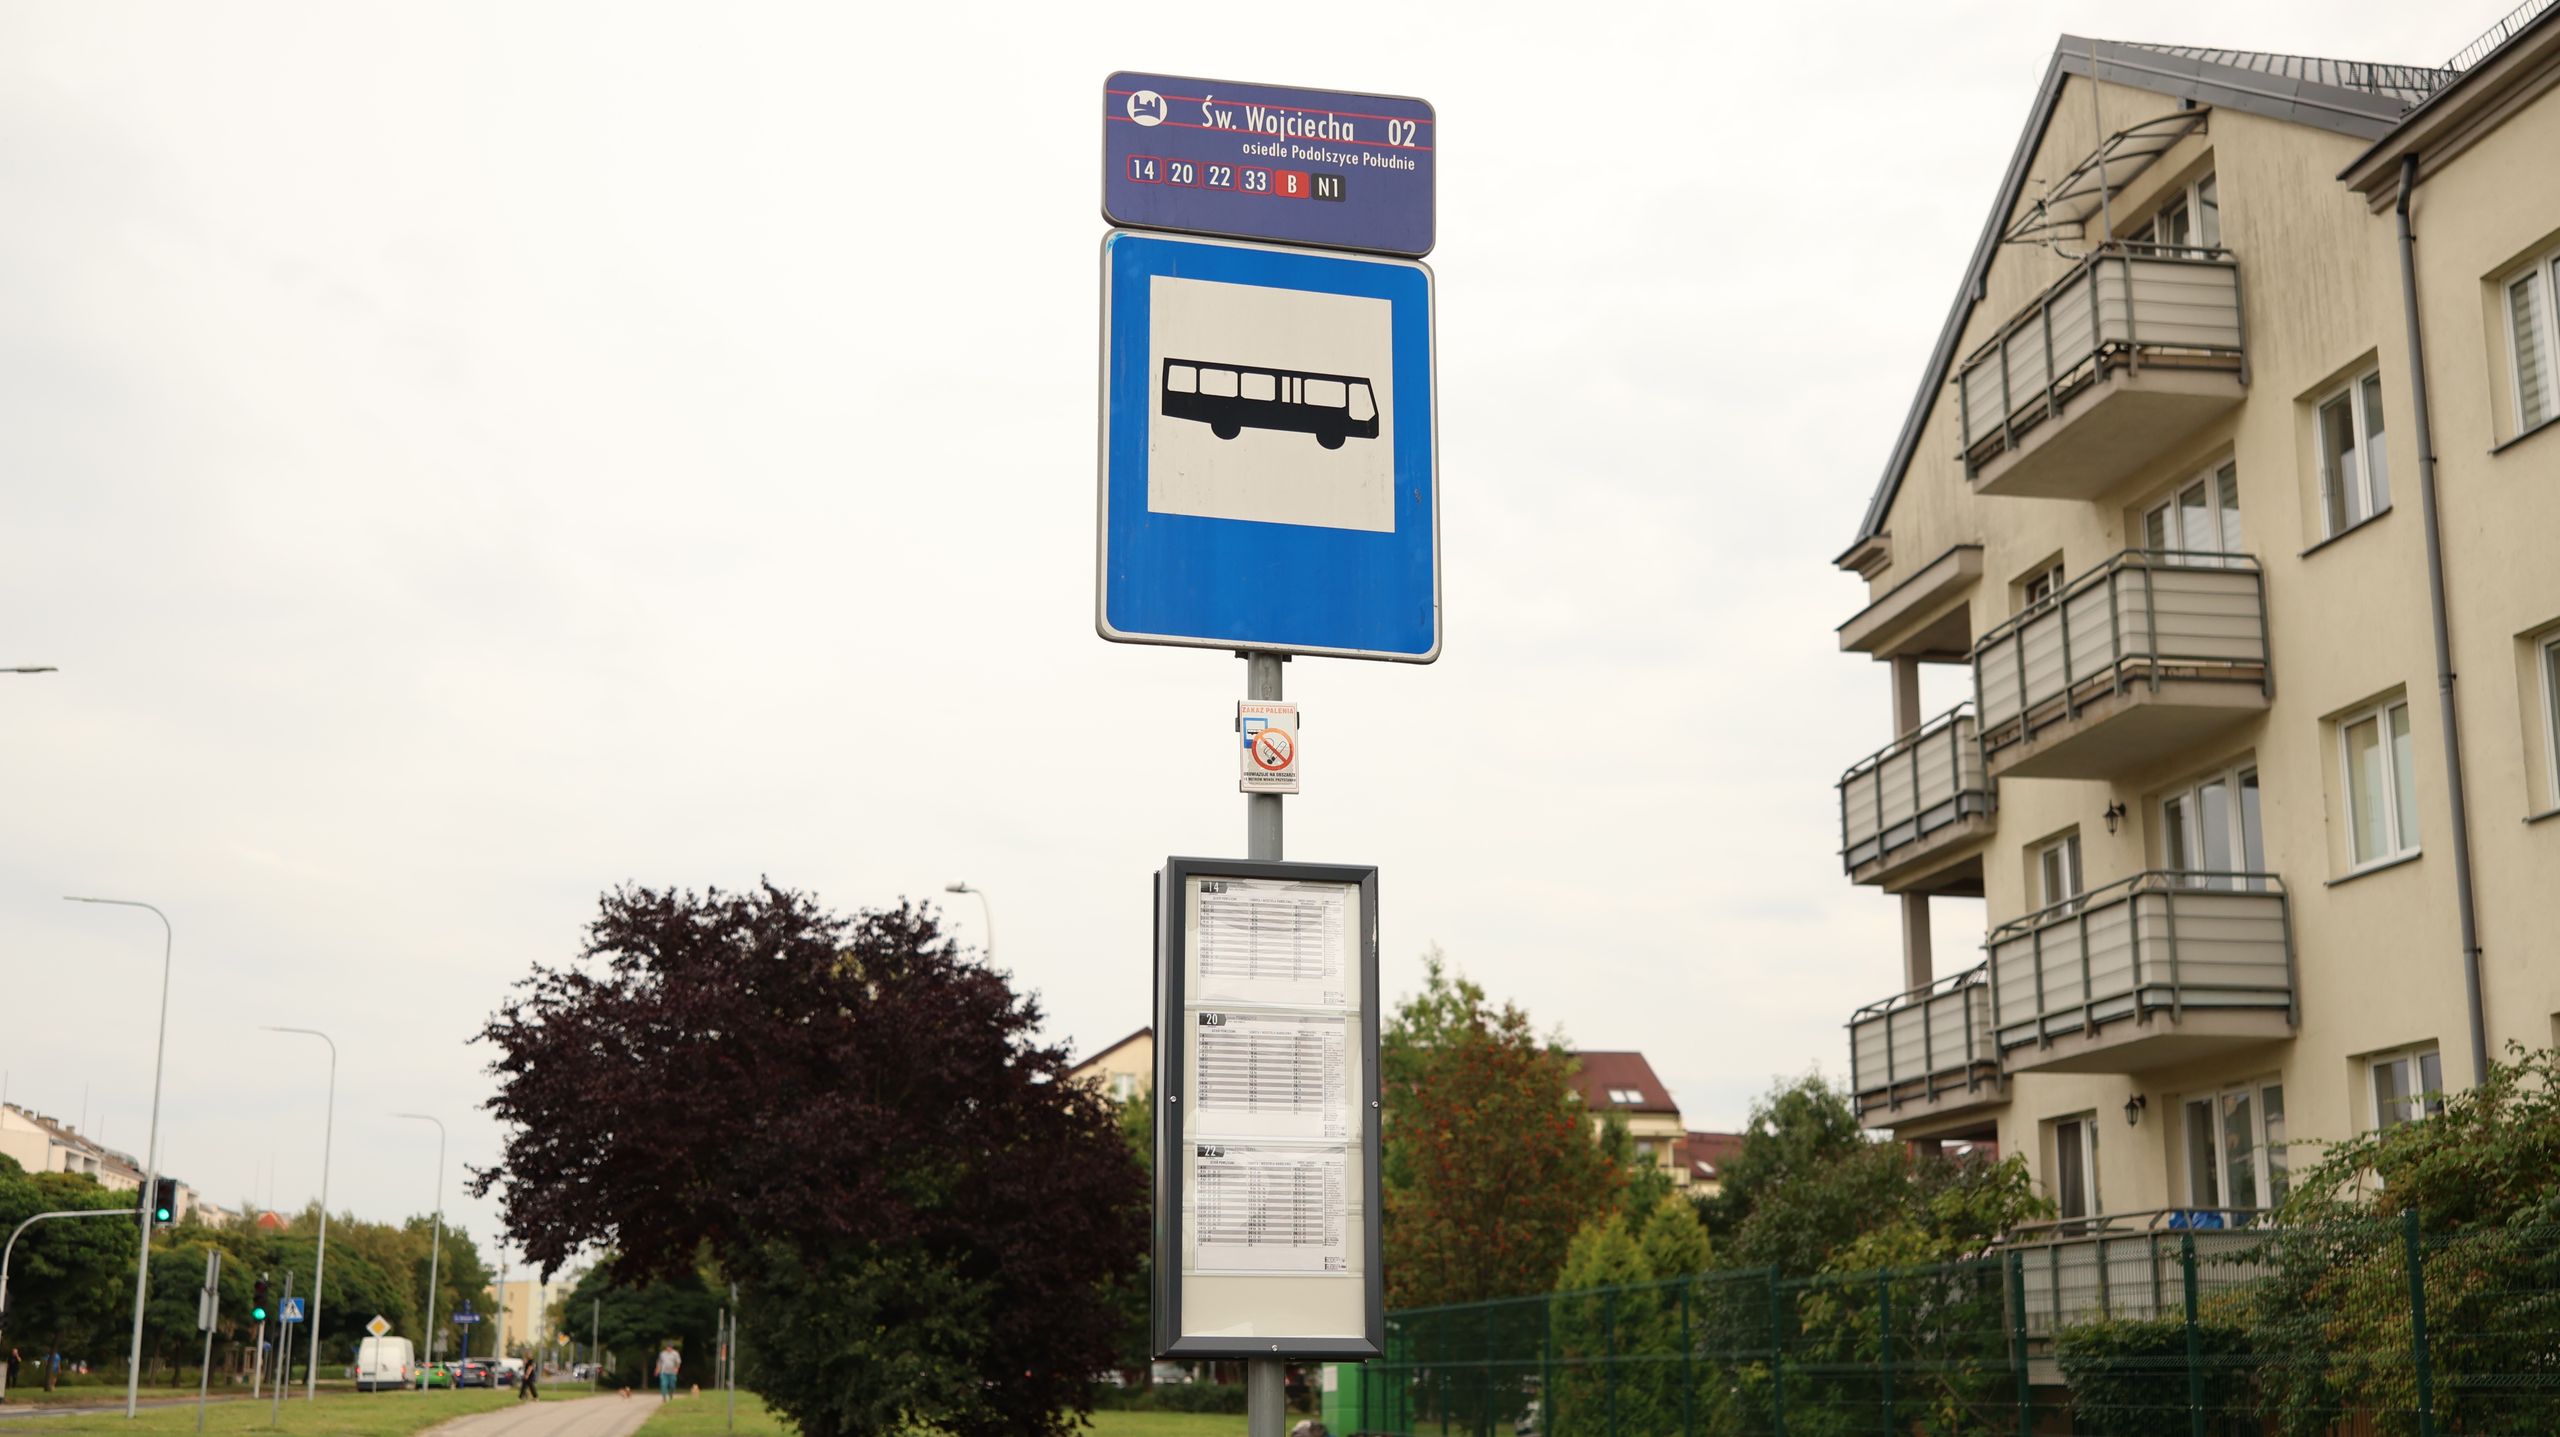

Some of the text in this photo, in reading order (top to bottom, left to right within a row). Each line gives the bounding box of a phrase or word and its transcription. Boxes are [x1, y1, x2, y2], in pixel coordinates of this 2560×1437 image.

[1202, 95, 1416, 147] Św. Wojciecha 02
[1242, 143, 1415, 171] osiedle Podolszyce Południe
[1134, 160, 1338, 198] 14 20 22 33 B N1
[1242, 706, 1294, 714] ZAKAZ PALENIA
[1208, 881, 1220, 893] 14
[1206, 1013, 1218, 1025] 20
[1204, 1145, 1216, 1157] 22
